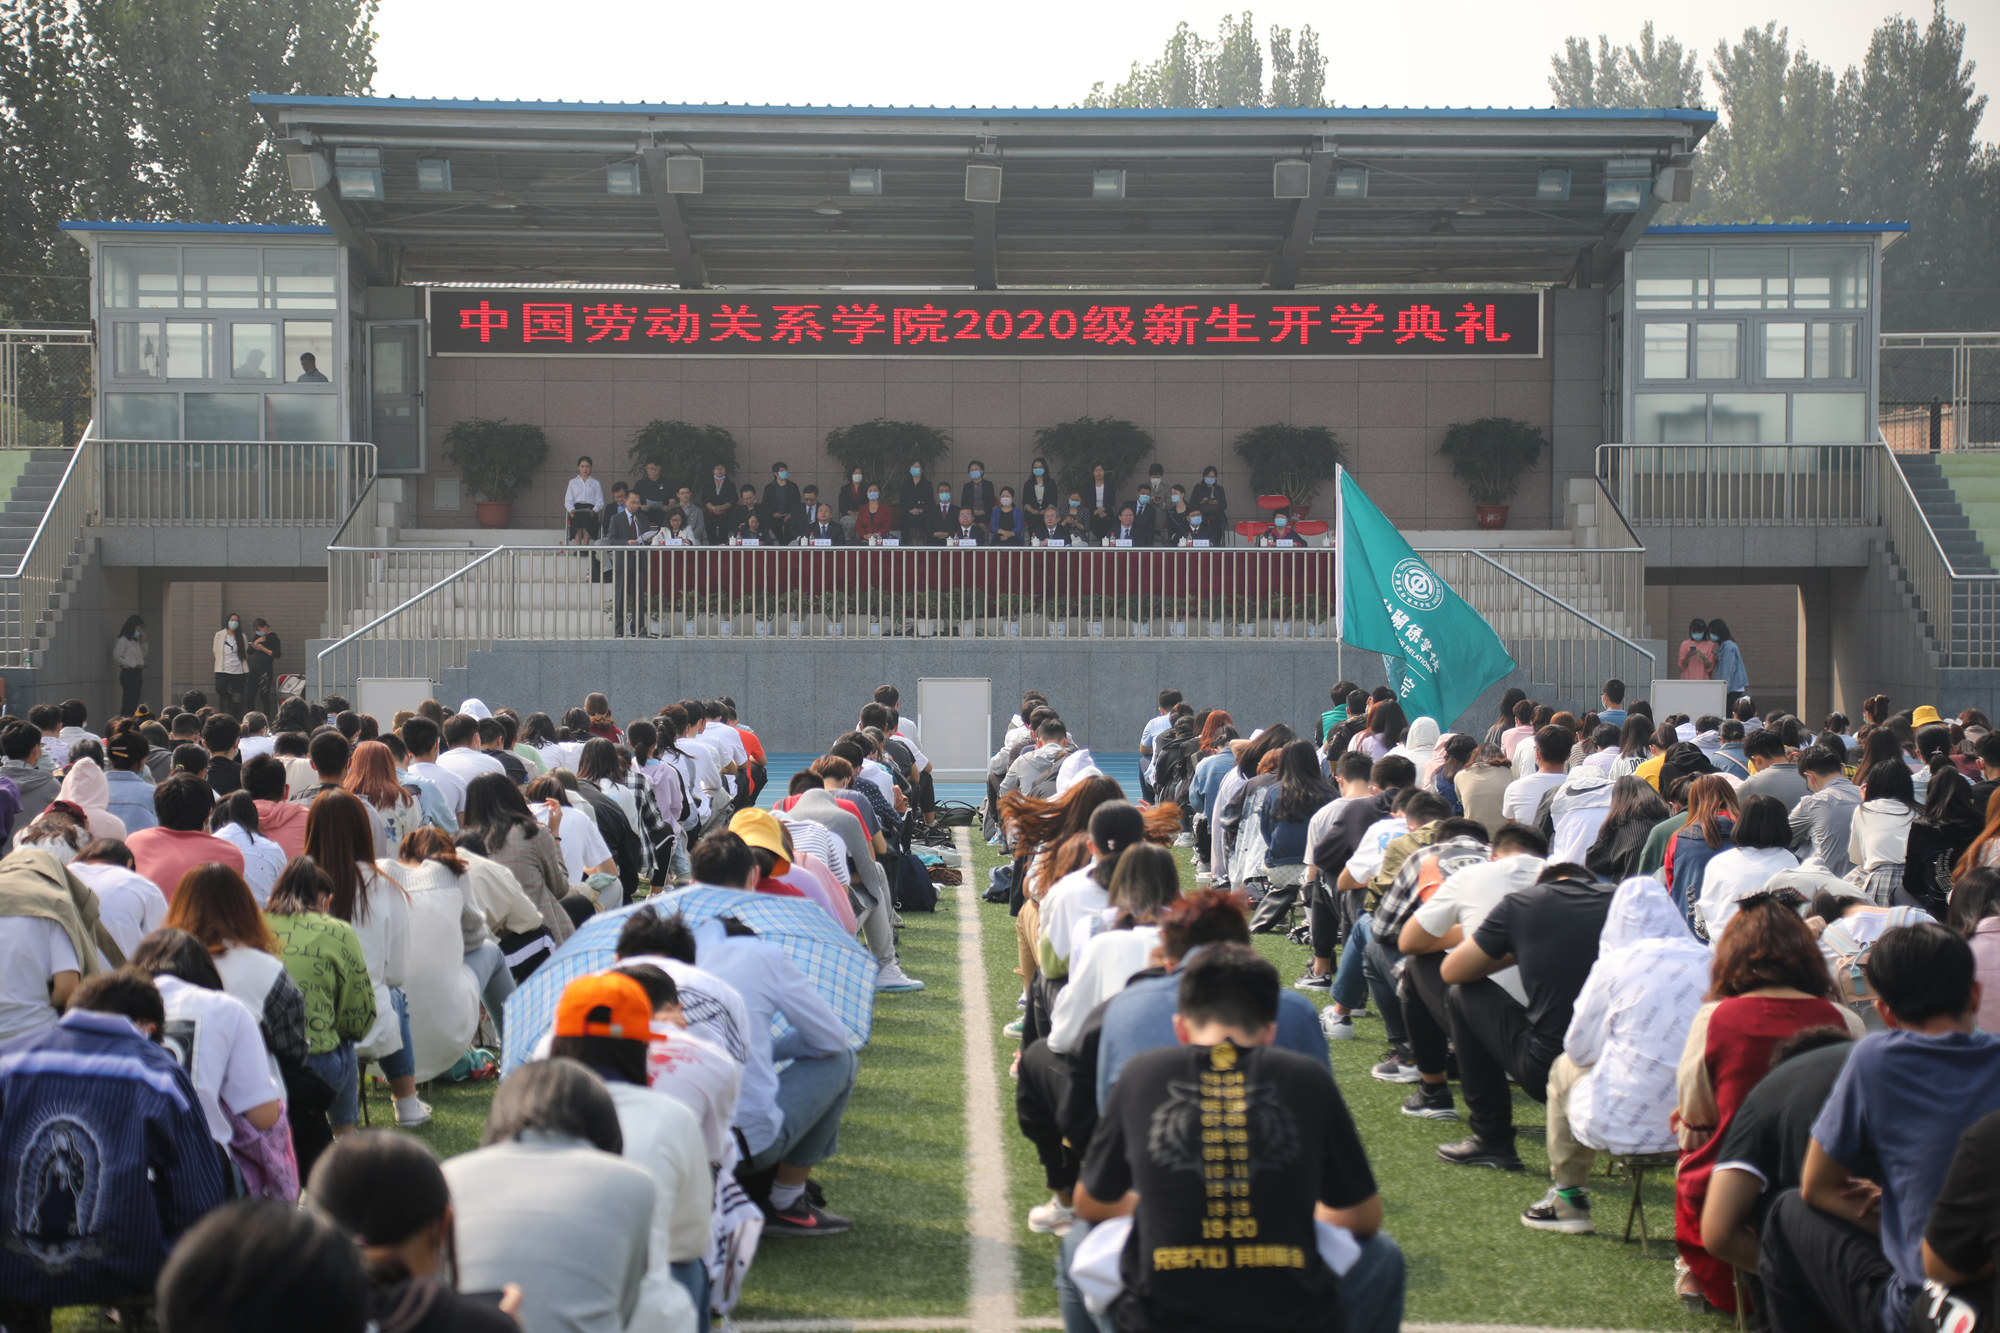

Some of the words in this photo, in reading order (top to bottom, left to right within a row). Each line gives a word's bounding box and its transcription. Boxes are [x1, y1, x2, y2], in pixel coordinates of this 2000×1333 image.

[460, 301, 1511, 345] 中国劳动关系学院2020级新生开学典礼
[1201, 1217, 1258, 1240] 19-20
